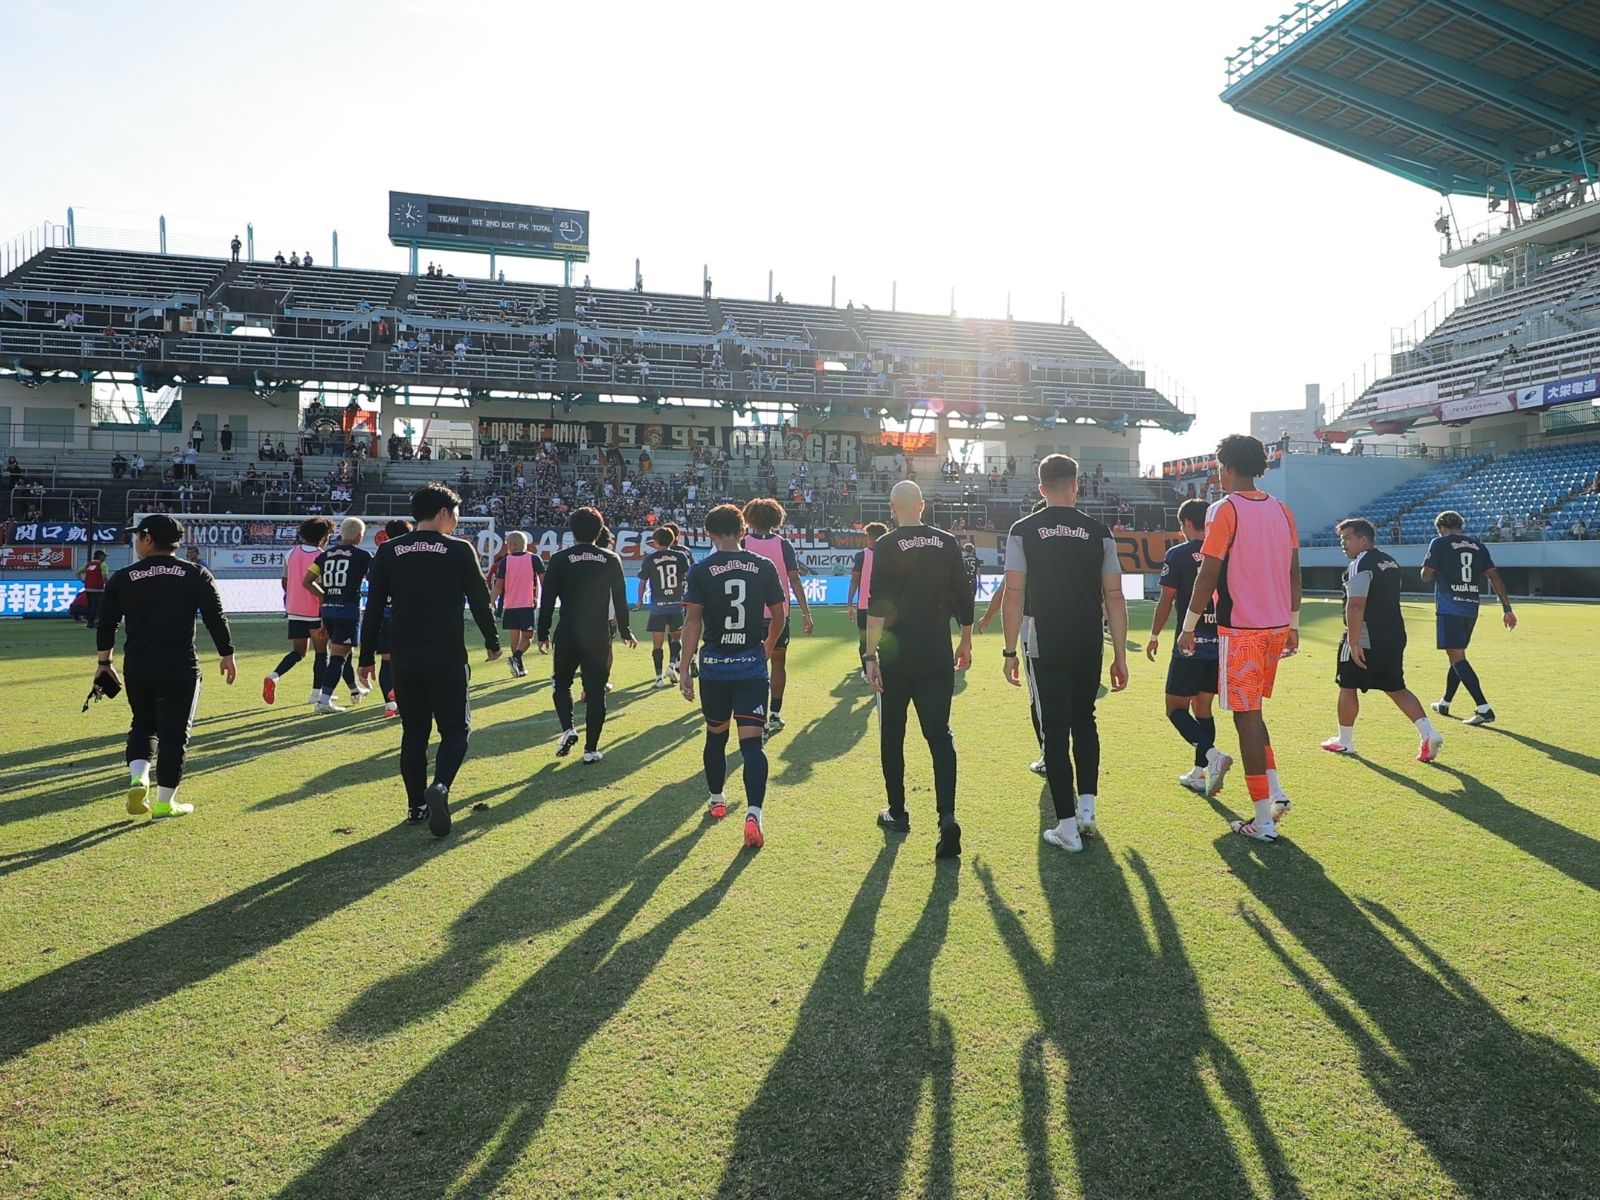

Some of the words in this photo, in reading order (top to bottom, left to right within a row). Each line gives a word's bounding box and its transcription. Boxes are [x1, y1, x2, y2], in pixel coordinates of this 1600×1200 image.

[438, 215, 459, 224] TEAM
[485, 220, 500, 228] 2ND
[532, 224, 552, 233] TOTAL
[559, 221, 569, 229] 45
[1547, 379, 1596, 399] 大栄電通
[1169, 455, 1210, 476] LOVE
[14, 524, 117, 541] 関口凱心
[1038, 525, 1061, 539] Red
[1062, 526, 1090, 539] Bulls
[394, 542, 418, 557] Red
[420, 542, 448, 554] Bulls
[898, 537, 919, 551] Red
[917, 536, 944, 549] Bulls
[129, 566, 155, 581] Red
[156, 566, 186, 577] Bulls
[323, 559, 350, 588] 88
[709, 560, 731, 576] Red
[732, 560, 759, 574] Bulls
[1460, 552, 1473, 583] 8
[656, 564, 678, 590] 18
[0, 582, 77, 613] 報技
[724, 578, 747, 630] 3
